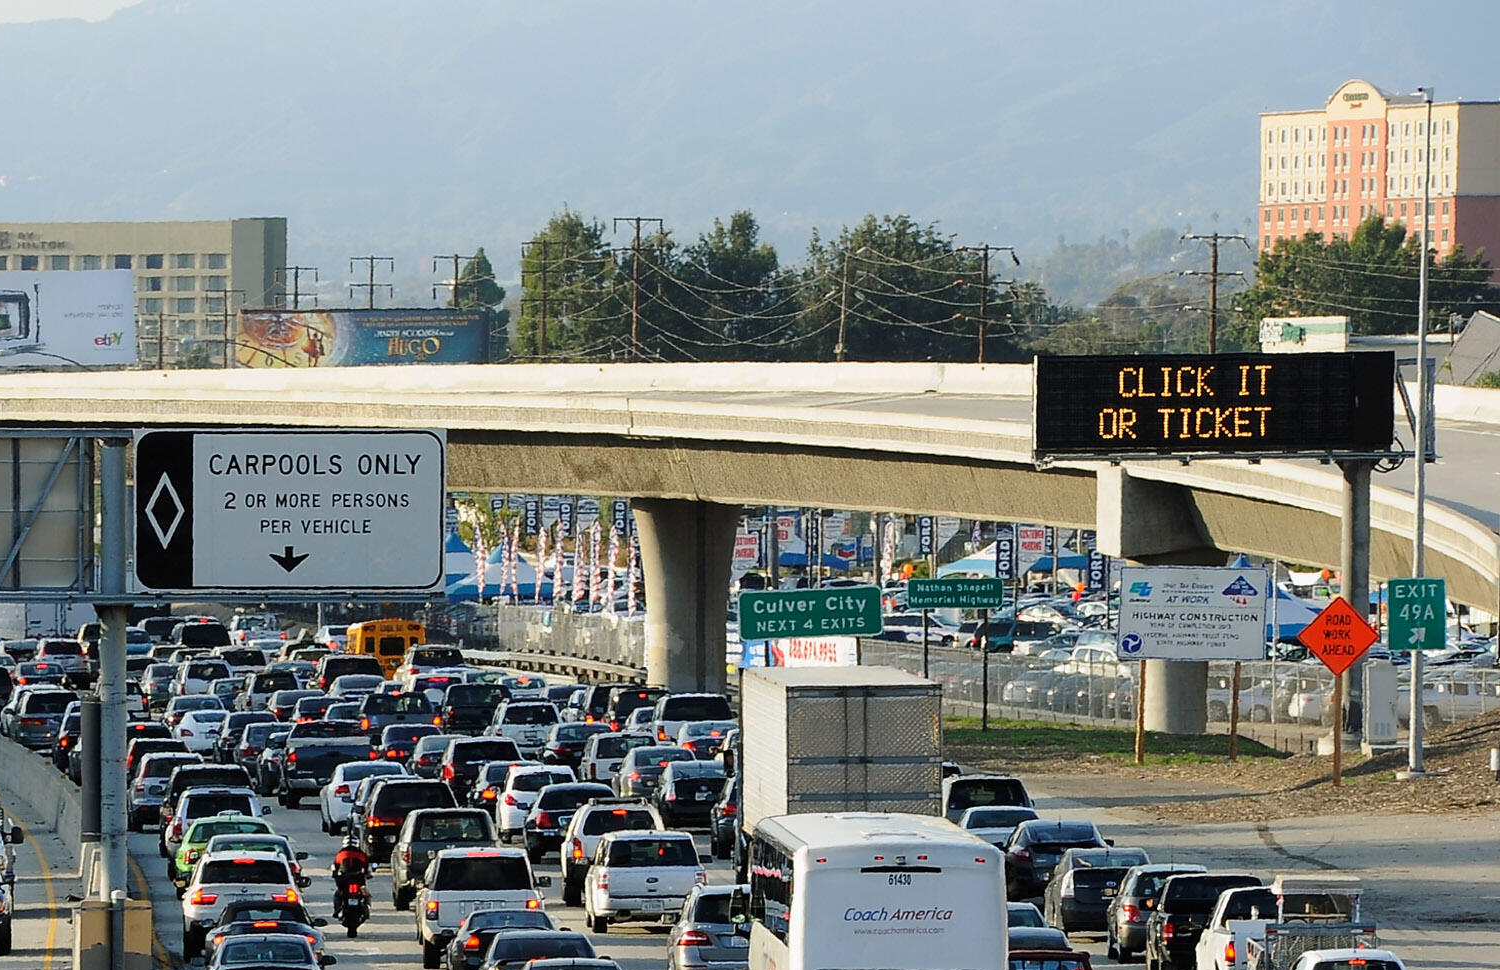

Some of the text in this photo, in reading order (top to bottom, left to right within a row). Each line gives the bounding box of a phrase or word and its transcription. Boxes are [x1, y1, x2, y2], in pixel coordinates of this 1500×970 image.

[17, 241, 66, 249] HILTON
[386, 337, 441, 356] HUGO
[1118, 365, 1273, 398] CLICK IT
[1098, 406, 1272, 439] OR TICKET
[208, 454, 422, 475] CARPOOLS ONLY
[223, 492, 410, 509] 2 OR MORE PERSONS
[526, 500, 536, 534] FORD
[260, 519, 372, 534] PER VEHICLE
[921, 517, 932, 553] FORD
[998, 540, 1010, 579] FORD
[916, 583, 952, 592] Nathan
[1395, 584, 1438, 599] EXIT
[752, 596, 867, 614] Culver City
[910, 594, 1000, 606] Memorial Highway
[1165, 596, 1210, 604] AT WORK
[1131, 611, 1259, 622] HIGHWAY CONSTRUCTION
[1325, 614, 1352, 625] ROAD
[1399, 604, 1435, 621] 49A
[756, 617, 866, 633] NEXT 4 EXITS
[1323, 629, 1351, 640] WORK
[1321, 644, 1356, 656] AHEAD
[843, 907, 954, 922] Coach America
